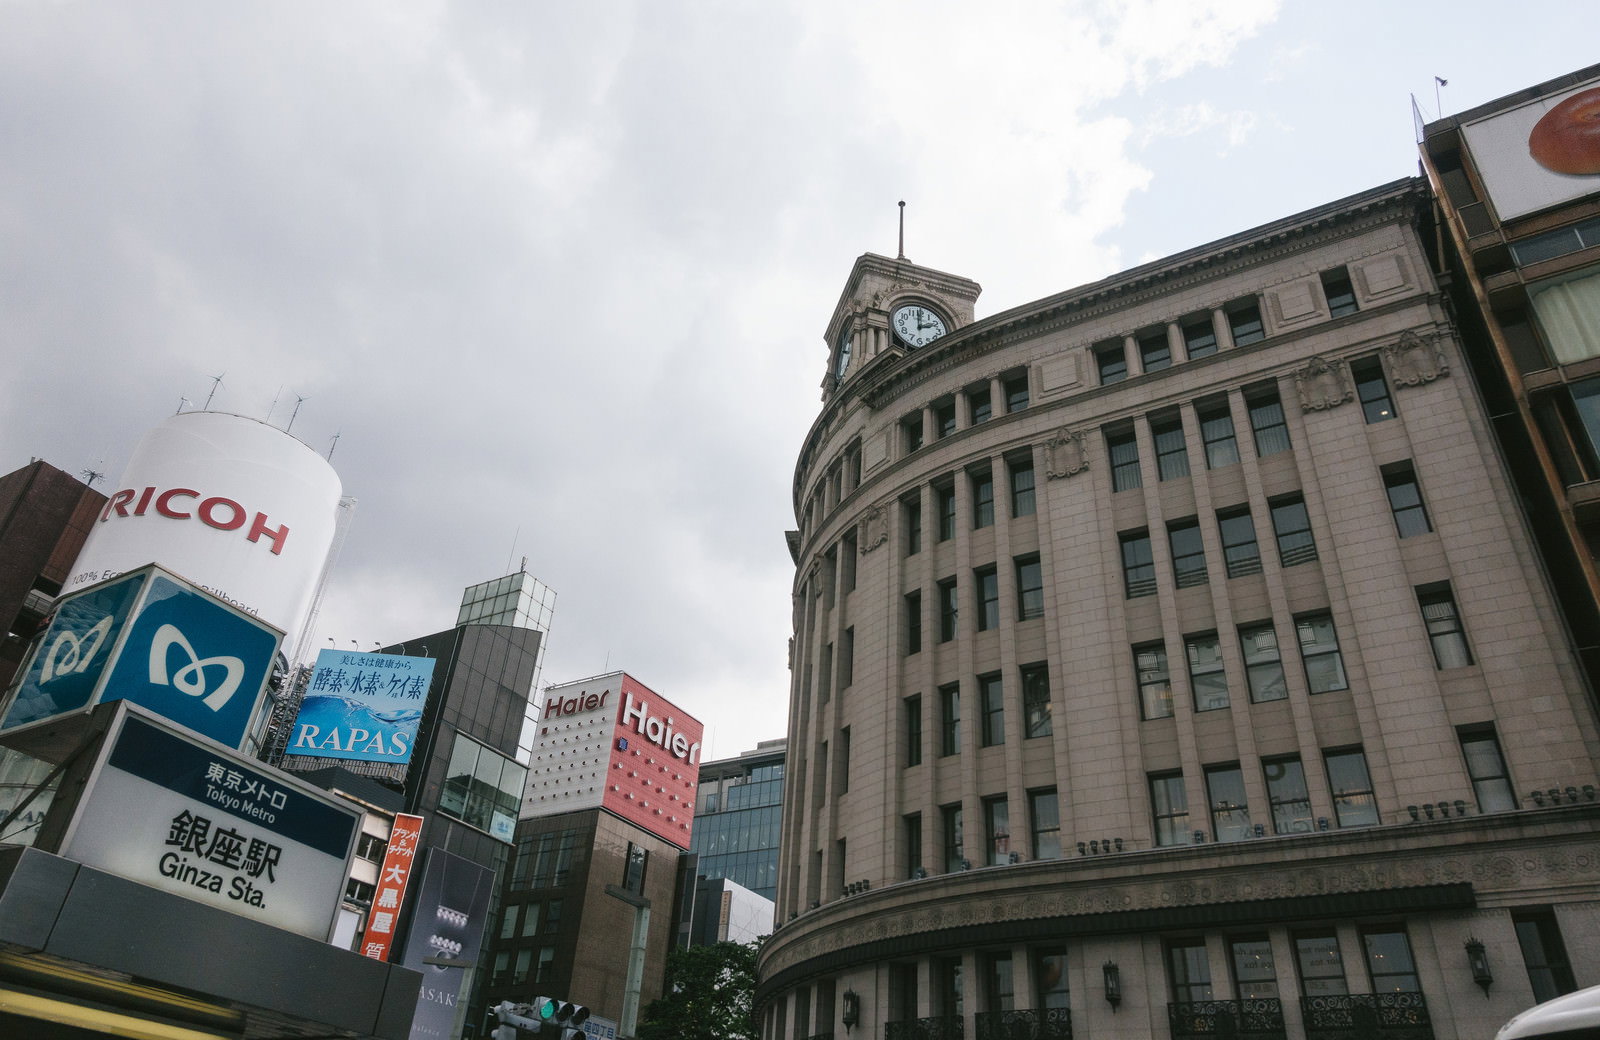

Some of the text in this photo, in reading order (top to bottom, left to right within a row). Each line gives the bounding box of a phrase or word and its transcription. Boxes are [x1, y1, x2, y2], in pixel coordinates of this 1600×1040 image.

[898, 319, 905, 327] 9
[909, 333, 915, 341] 7
[100, 486, 290, 556] RICOH
[72, 570, 98, 585] 100%
[340, 655, 412, 670] 美しさは健康から
[544, 689, 610, 719] Haier
[293, 723, 410, 757] RAPAS
[622, 691, 701, 766] Haier
[204, 761, 288, 810] 東京メトロ
[206, 784, 276, 824] Tokyo Metro
[165, 809, 283, 884] 銀座駅
[393, 827, 419, 841] ブランド
[388, 844, 414, 857] チケット
[159, 851, 266, 909] Ginza Sta.
[370, 864, 406, 934] 大黒屋
[419, 986, 458, 1008] ASAK
